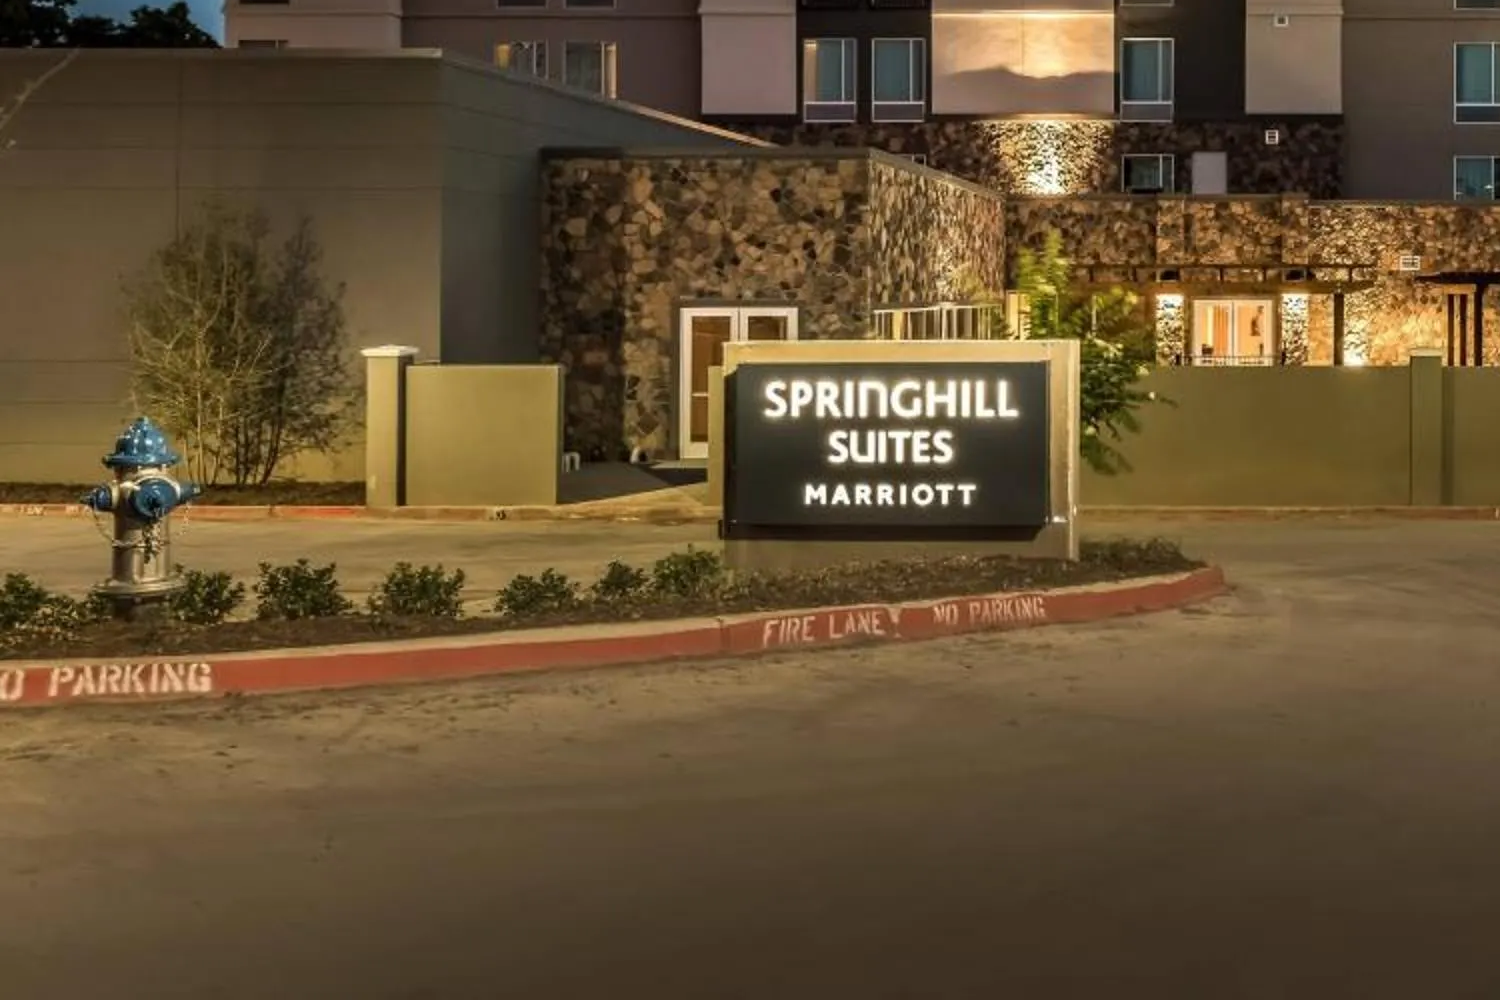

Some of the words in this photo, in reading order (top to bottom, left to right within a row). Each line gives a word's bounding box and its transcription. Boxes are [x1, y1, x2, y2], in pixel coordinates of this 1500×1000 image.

[764, 380, 1019, 418] SPRINGHILL
[828, 430, 954, 463] SUITES
[804, 484, 977, 505] MARRIOTT
[763, 616, 816, 648] FIRE
[829, 611, 886, 639] LANE
[933, 603, 959, 624] NO
[968, 597, 1045, 625] PARKING
[0, 669, 24, 701] O
[47, 663, 211, 697] PARKING
